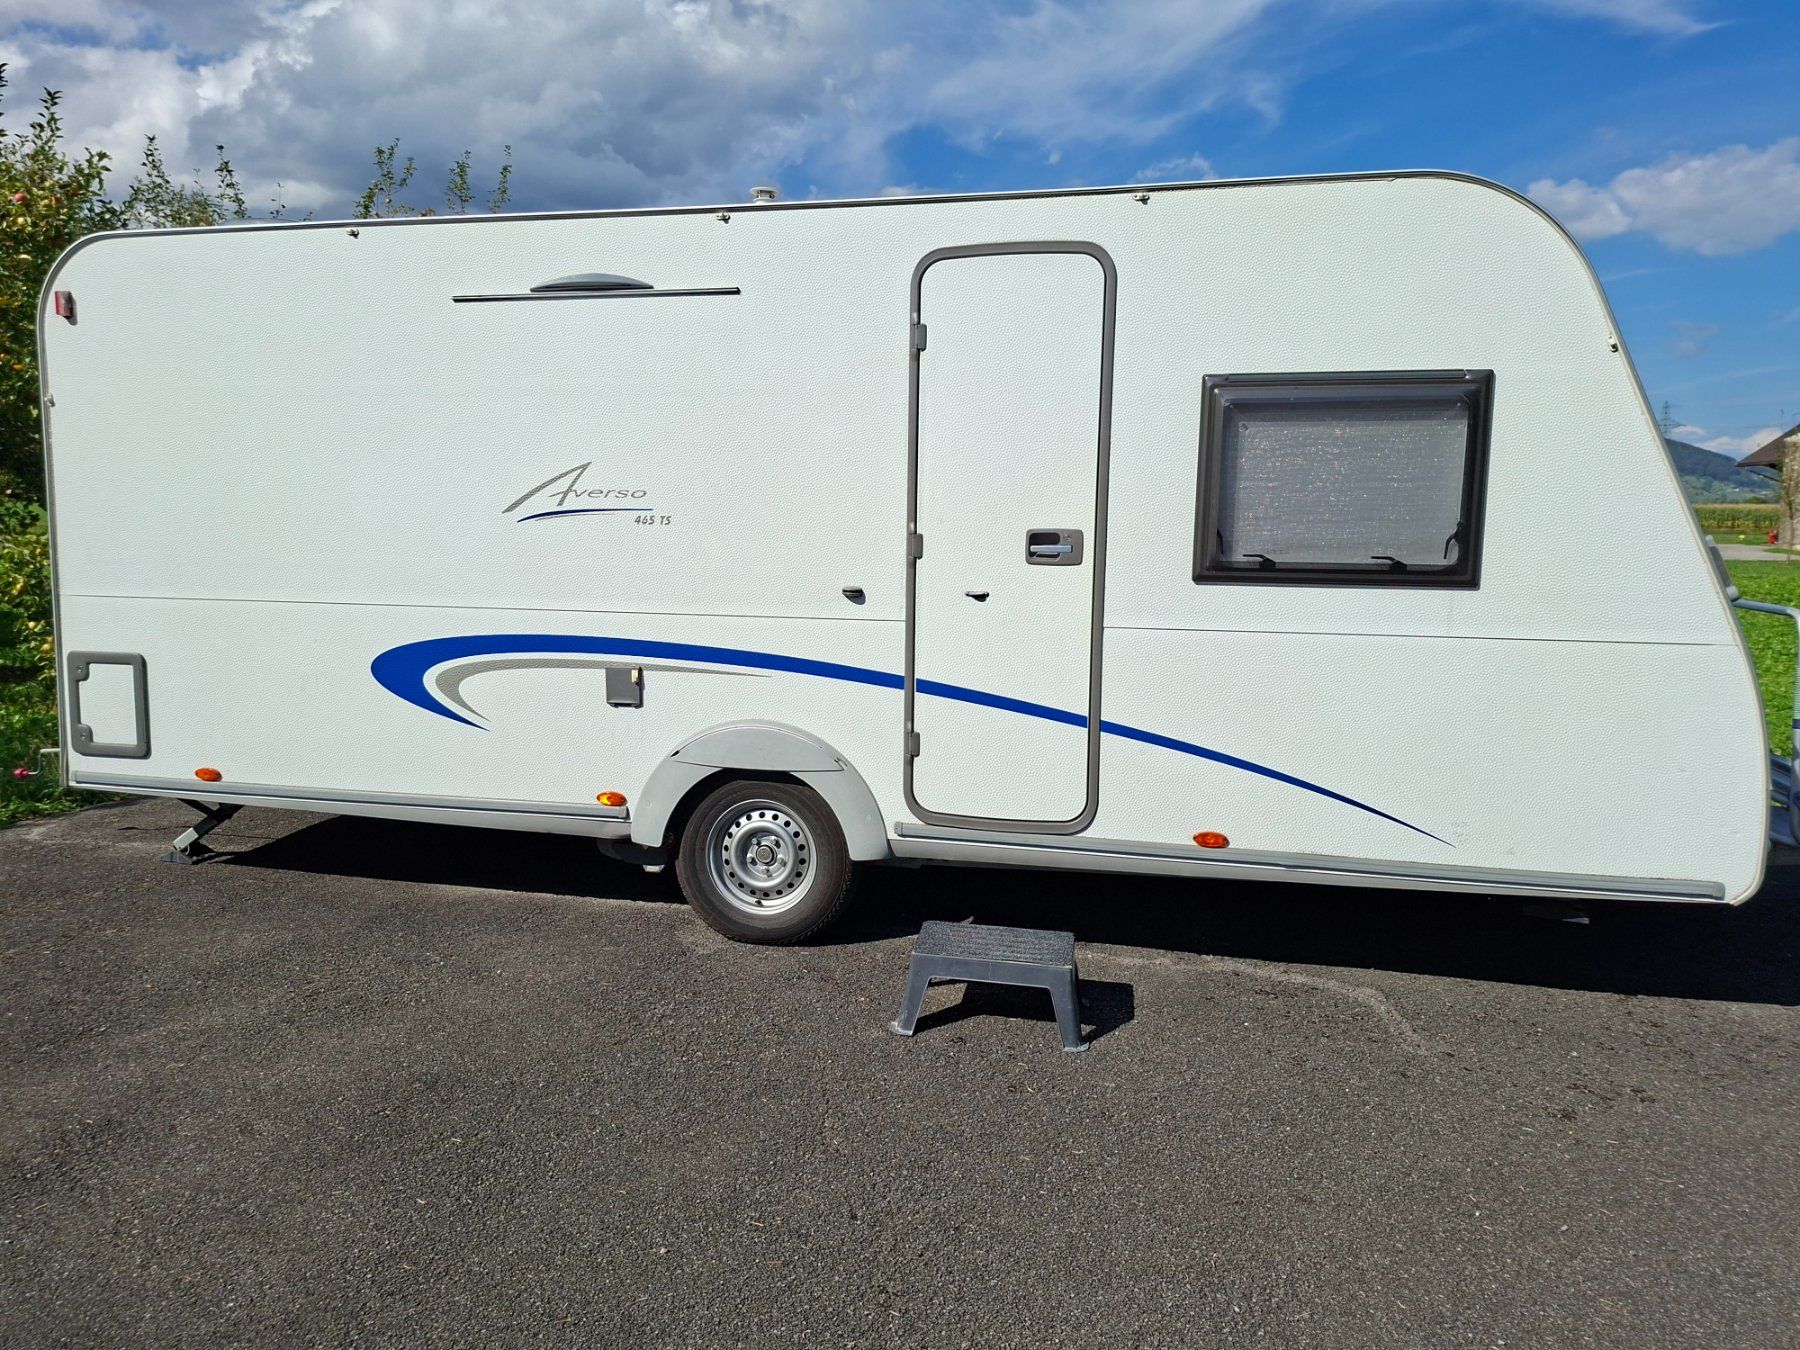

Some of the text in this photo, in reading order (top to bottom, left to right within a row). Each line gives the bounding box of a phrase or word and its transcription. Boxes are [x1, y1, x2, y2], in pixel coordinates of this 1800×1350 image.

[502, 461, 647, 514] Averso
[634, 515, 672, 525] 465 TS
